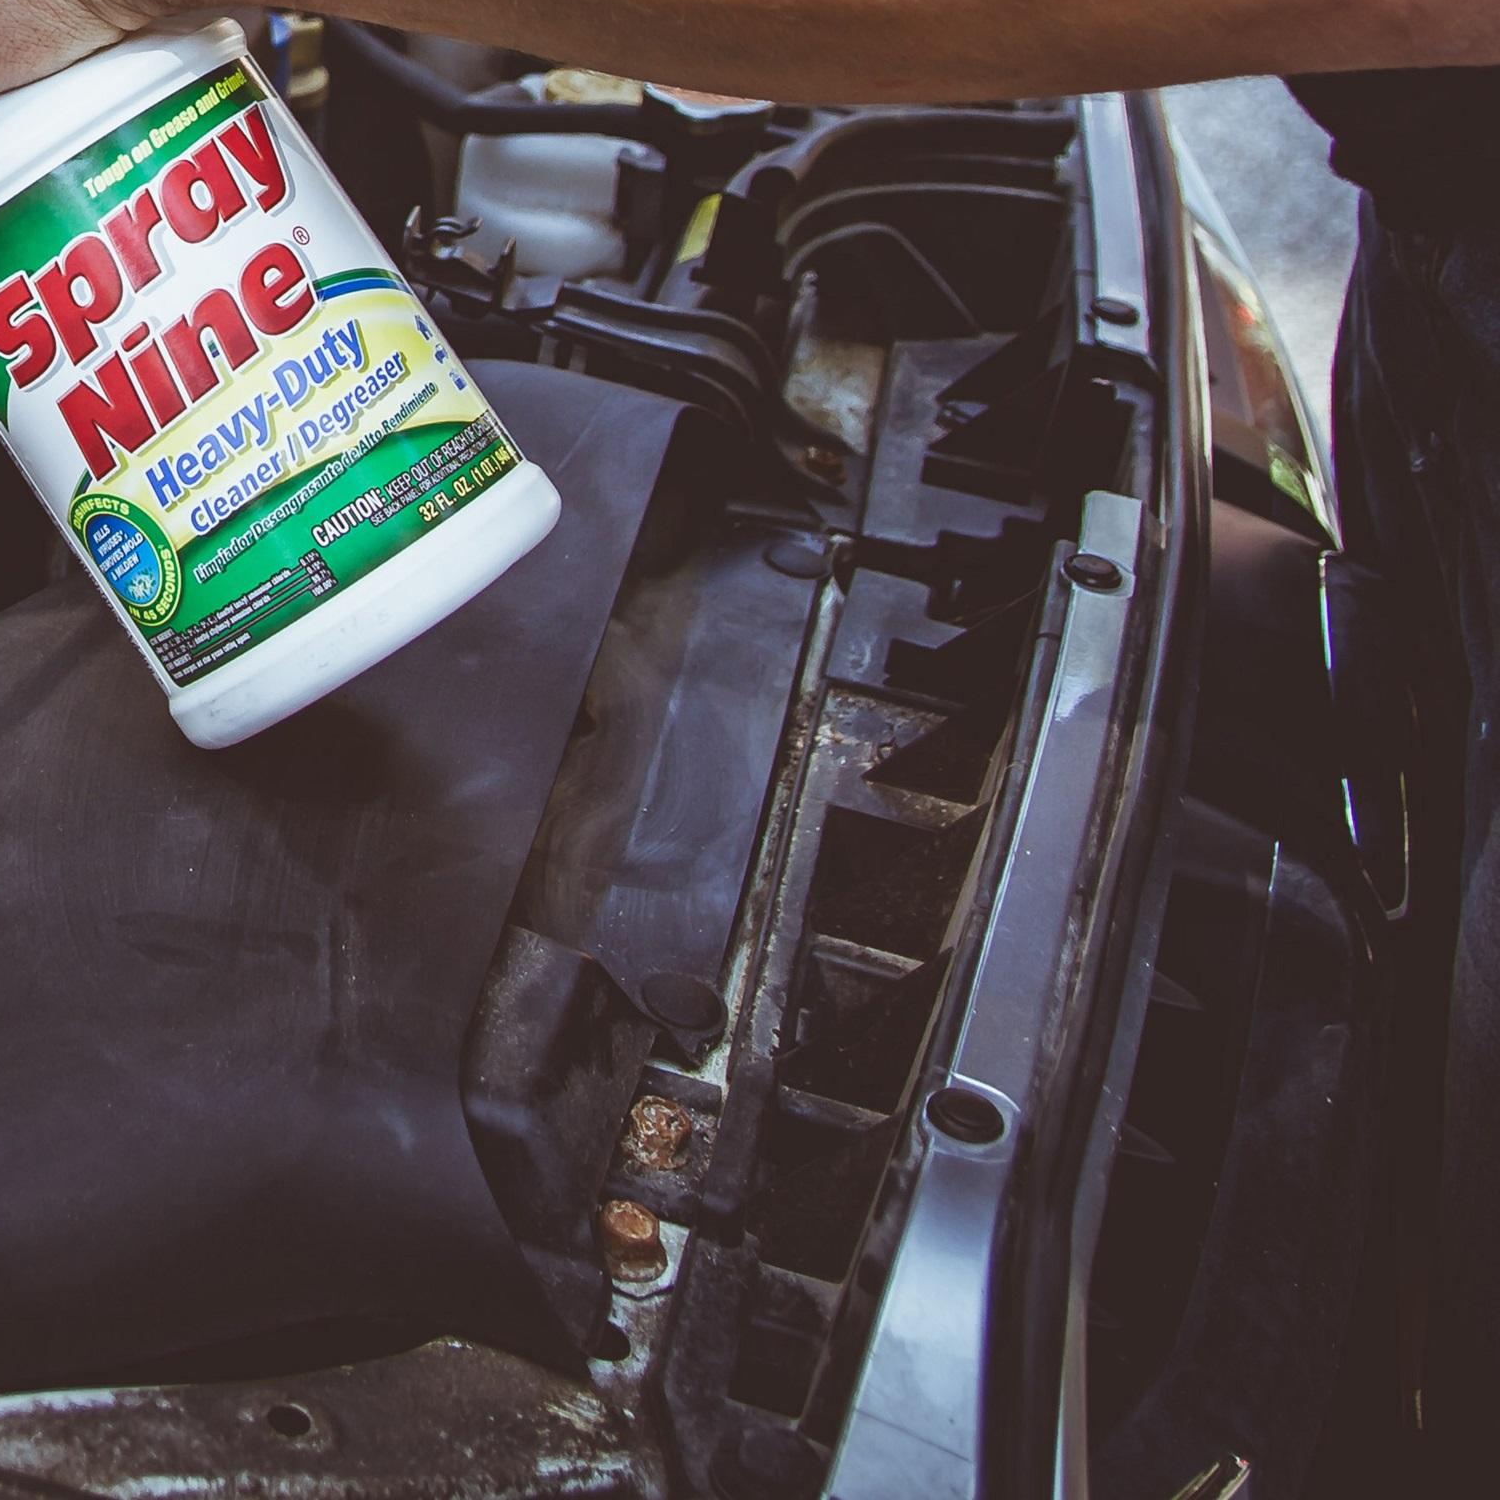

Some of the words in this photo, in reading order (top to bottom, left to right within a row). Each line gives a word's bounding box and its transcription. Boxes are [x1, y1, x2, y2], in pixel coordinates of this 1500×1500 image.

[82, 153, 134, 197] Tough
[128, 137, 154, 164] on
[147, 104, 199, 149] Grease
[194, 86, 221, 115] and
[214, 67, 247, 99] Grime!
[55, 243, 316, 480] Nine
[144, 320, 362, 507] Heavy-Duty
[188, 450, 282, 532] Cleaner
[298, 352, 404, 448] Degreaser
[73, 498, 128, 529] DISINFECTS
[193, 532, 254, 583] Limpiador
[250, 461, 343, 539] Desengrasante
[341, 447, 360, 466] de
[359, 429, 383, 453] Alto
[380, 380, 437, 433] Rendimiento
[310, 488, 386, 548] CAUTION:
[383, 471, 412, 499] KEEP
[409, 457, 433, 481] OUT
[428, 448, 446, 468] OF
[439, 432, 469, 460] REACH
[462, 425, 477, 443] OF
[369, 510, 386, 526] SEE
[382, 498, 402, 517] BACK
[399, 486, 421, 506] PANEL
[417, 476, 433, 492] FOR
[428, 456, 461, 485] ADDITIONAL
[417, 499, 439, 522] 32
[433, 490, 457, 511] FL.
[451, 475, 475, 497] OZ.
[469, 466, 484, 486] (1
[478, 453, 502, 477] QT.)
[92, 523, 111, 543] KILLS
[113, 551, 140, 578] MILDEW
[121, 530, 144, 554] MOLD
[128, 605, 141, 617] IN
[143, 610, 157, 620] 45
